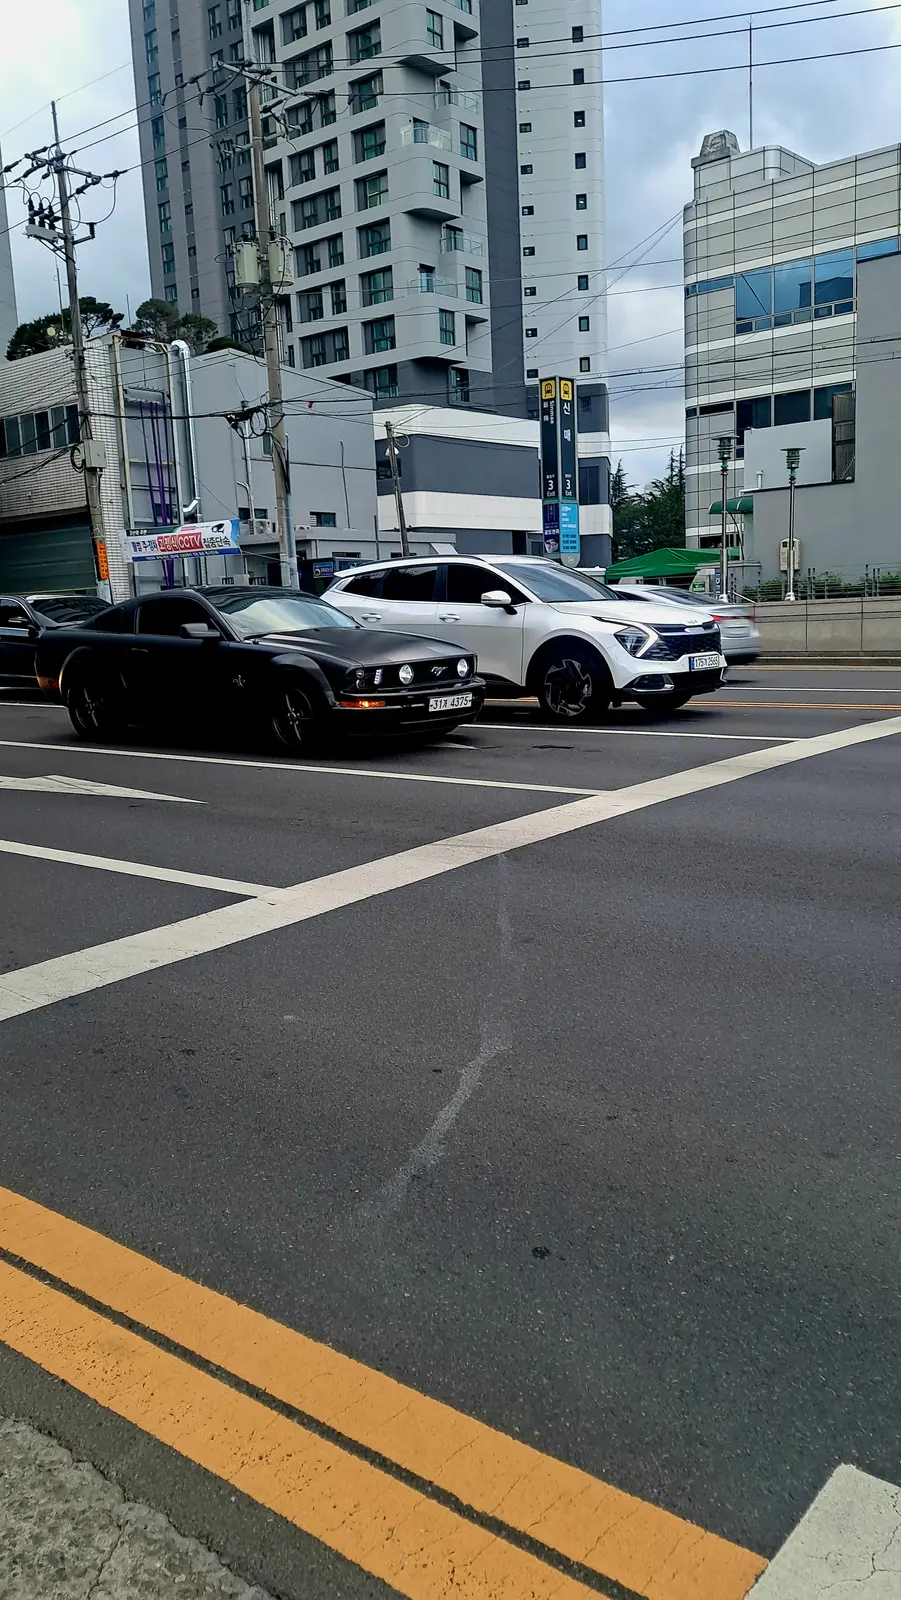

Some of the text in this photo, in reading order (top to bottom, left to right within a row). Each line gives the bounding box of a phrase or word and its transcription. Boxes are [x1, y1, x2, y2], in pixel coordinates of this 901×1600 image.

[563, 402, 571, 441] 신매
[547, 480, 554, 490] 3
[566, 479, 571, 490] 3
[179, 534, 201, 549] CCTV
[202, 535, 232, 549] 집중단속
[450, 696, 469, 707] 4375
